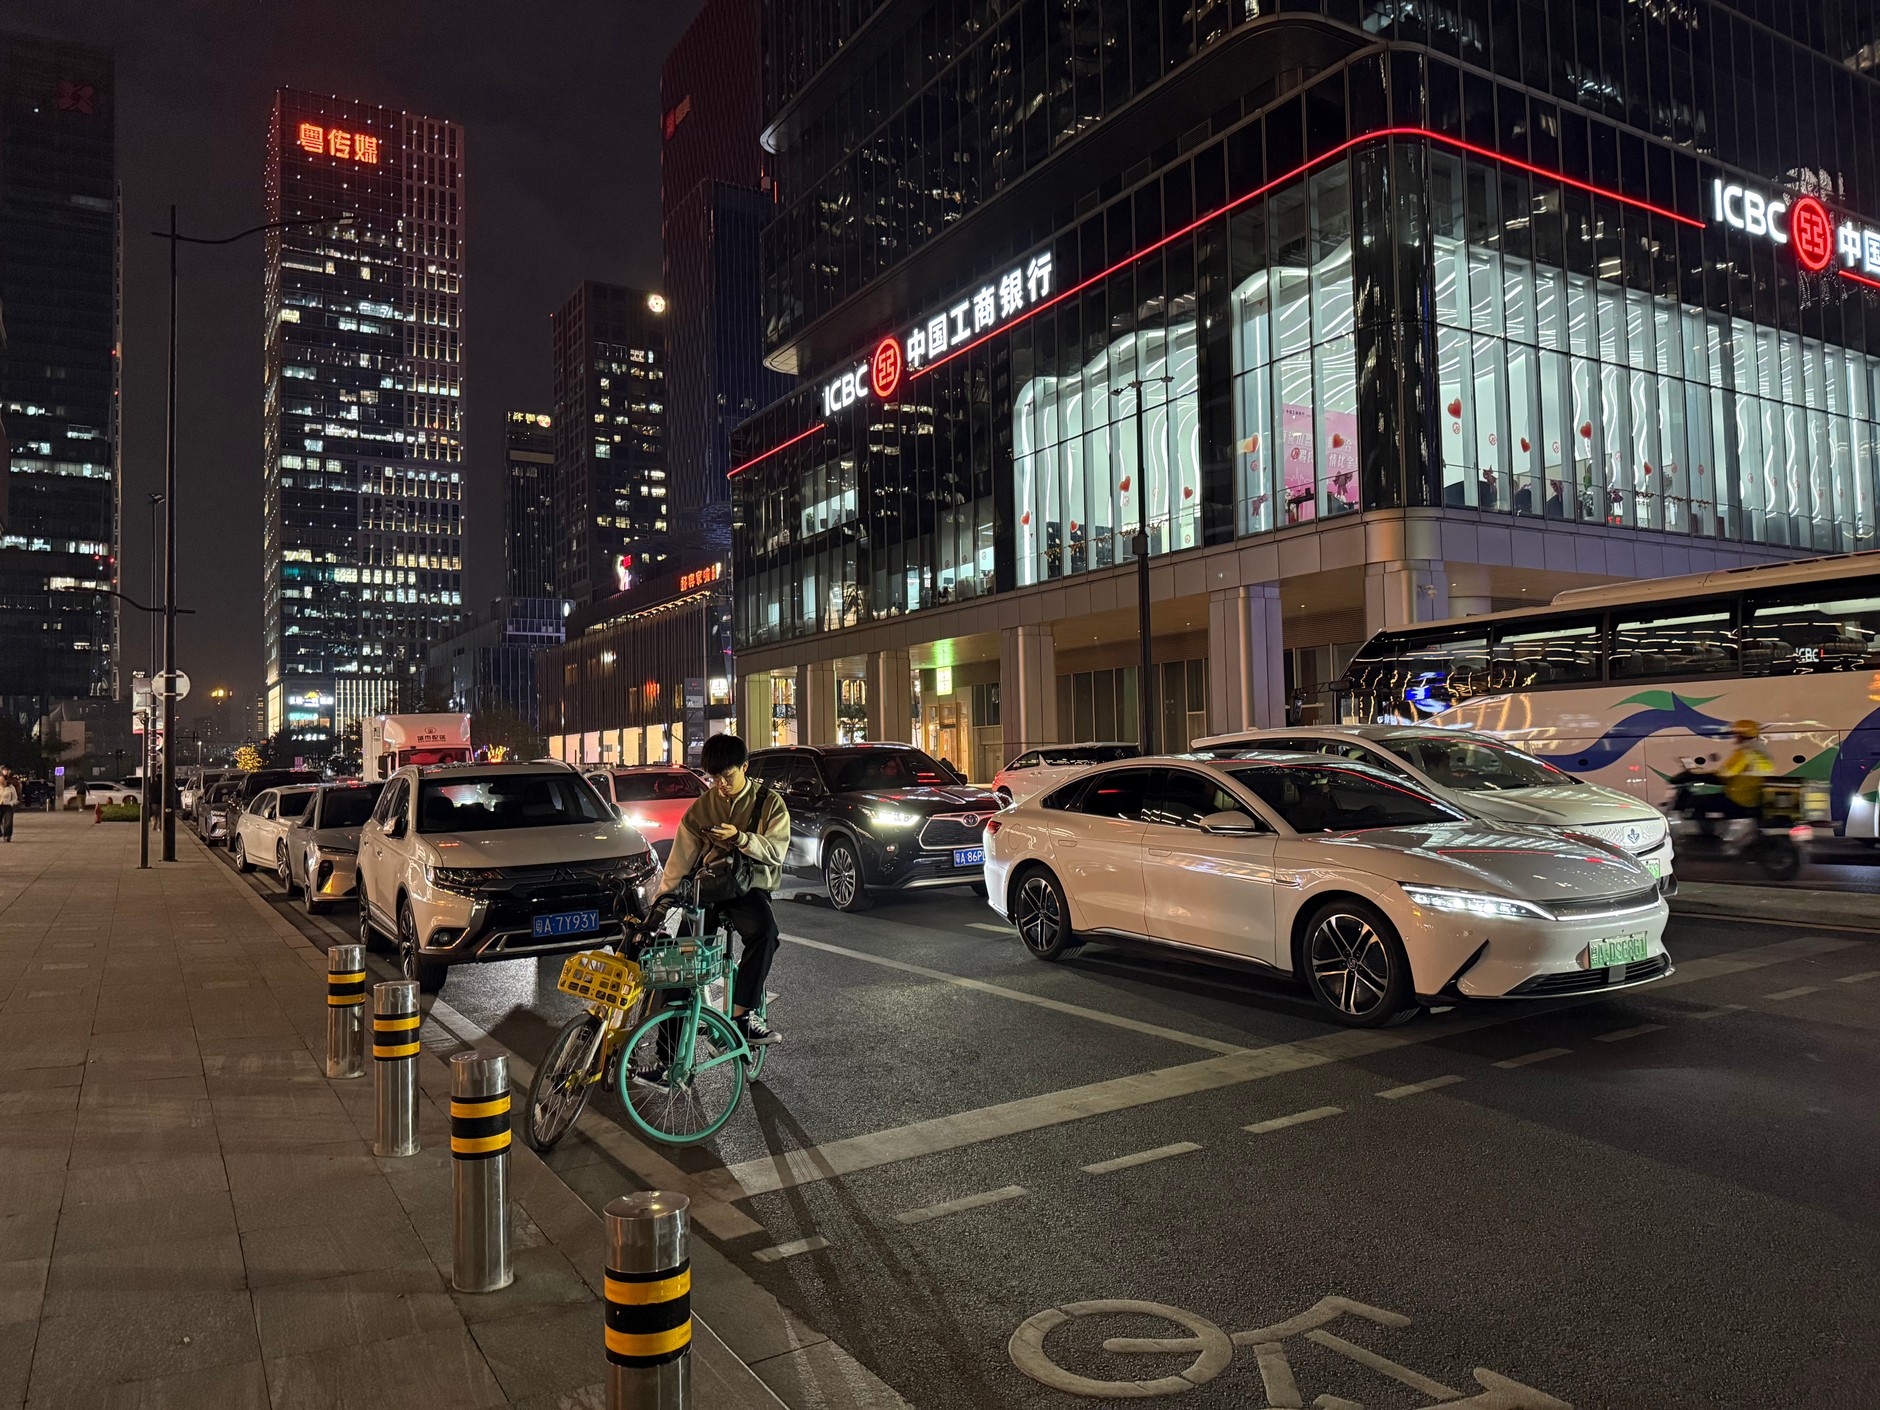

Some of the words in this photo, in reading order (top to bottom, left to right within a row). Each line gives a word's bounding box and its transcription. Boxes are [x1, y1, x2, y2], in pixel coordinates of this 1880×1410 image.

[299, 123, 378, 164] 粤传媒
[1714, 178, 1787, 244] ICBC
[906, 252, 1052, 367] 中国工商银行
[823, 364, 869, 416] ICBC
